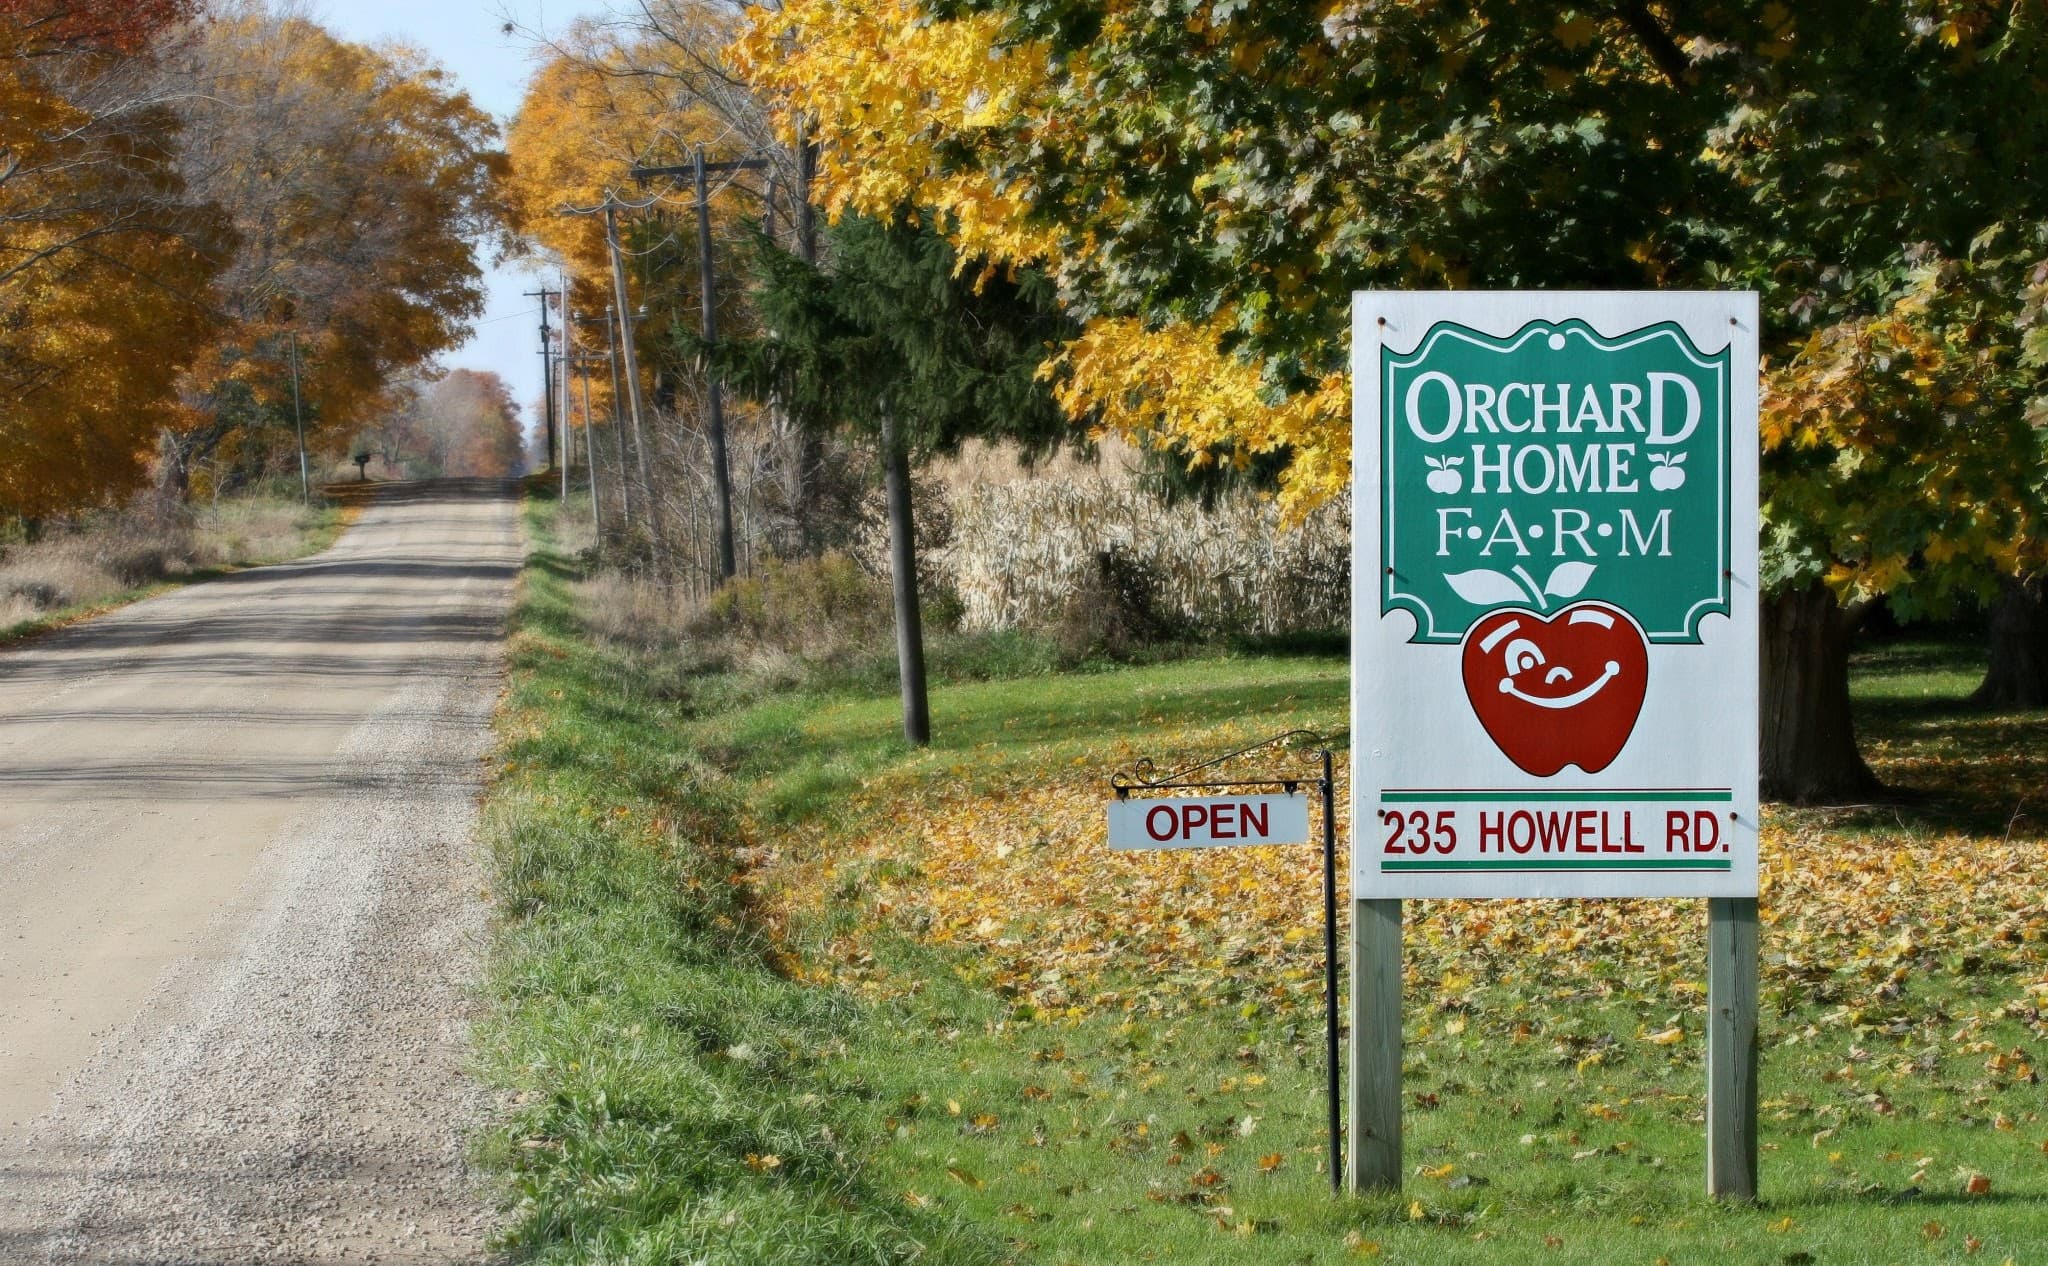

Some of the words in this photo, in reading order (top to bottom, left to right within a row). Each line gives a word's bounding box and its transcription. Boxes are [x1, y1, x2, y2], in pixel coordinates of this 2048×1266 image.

[1405, 371, 1701, 444] ORCHARD
[1471, 443, 1639, 493] HOME
[1145, 802, 1269, 842] OPEN
[1383, 810, 1457, 854] 235
[1479, 810, 1644, 854] HOWELL
[1665, 811, 1730, 853] RD.
